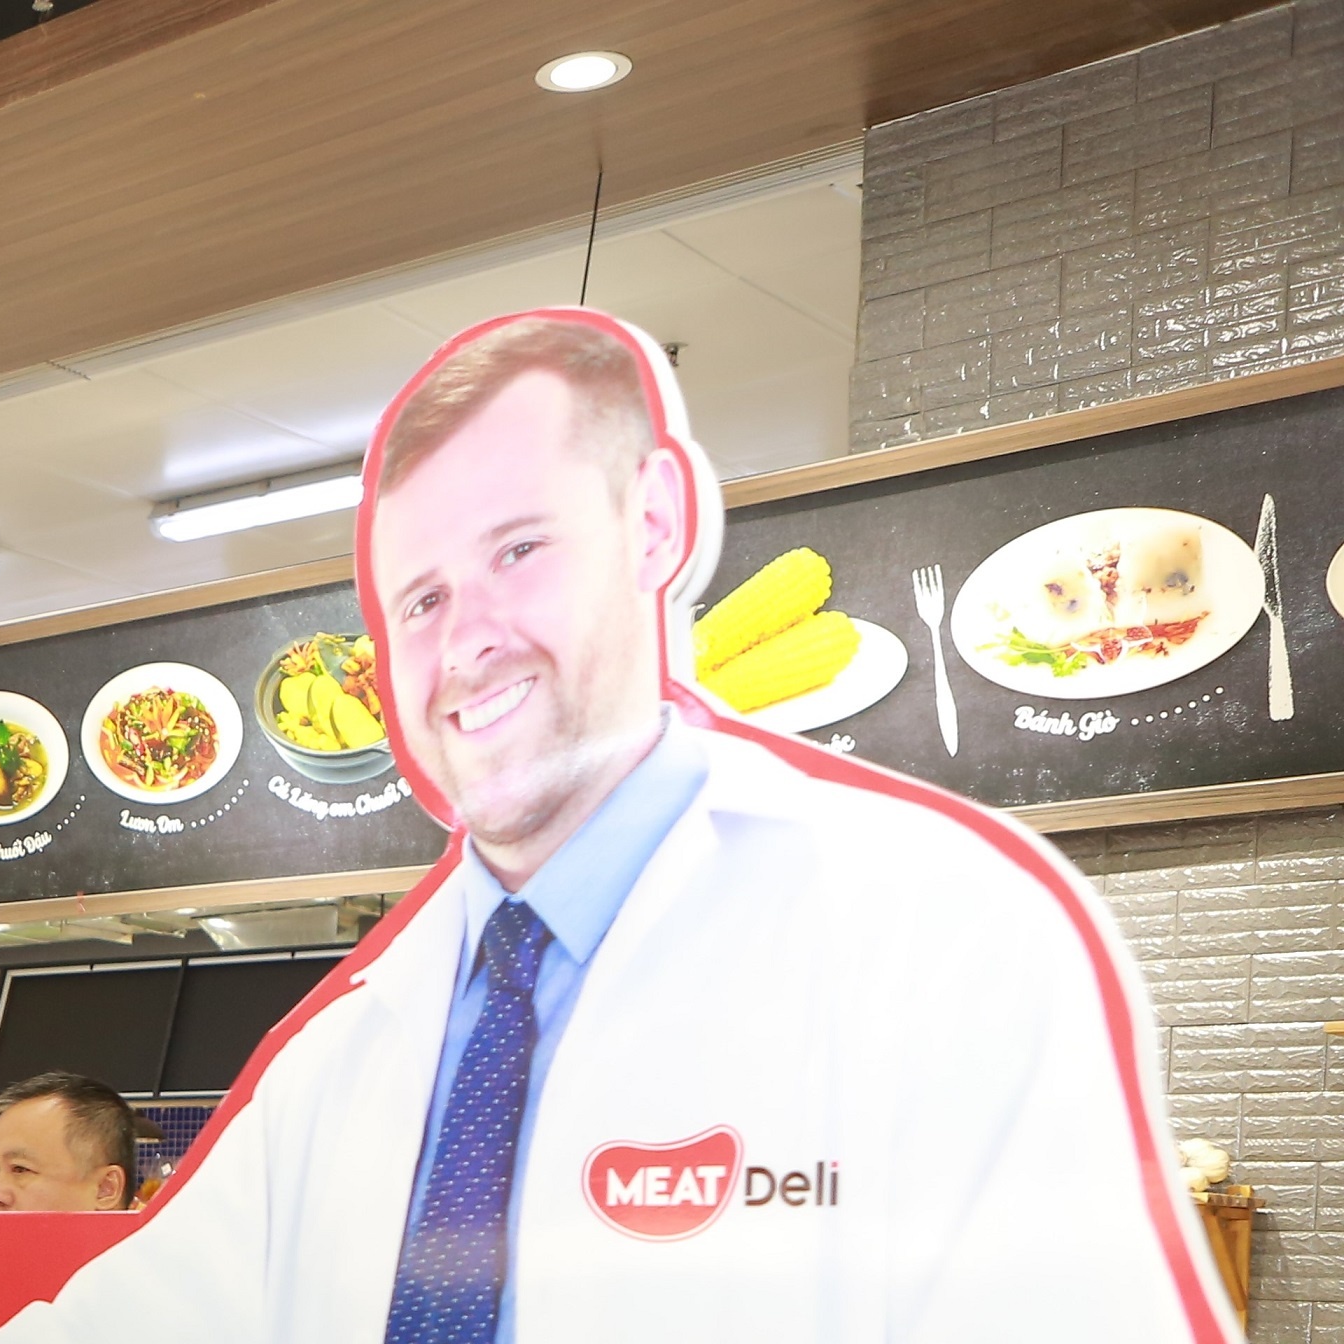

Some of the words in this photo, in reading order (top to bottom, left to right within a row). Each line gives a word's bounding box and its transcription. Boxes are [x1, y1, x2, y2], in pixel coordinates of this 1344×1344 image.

[1014, 706, 1078, 735] Bánh
[1078, 709, 1120, 741] Giò
[606, 1165, 726, 1206] MEAT
[744, 1161, 838, 1206] Deli
